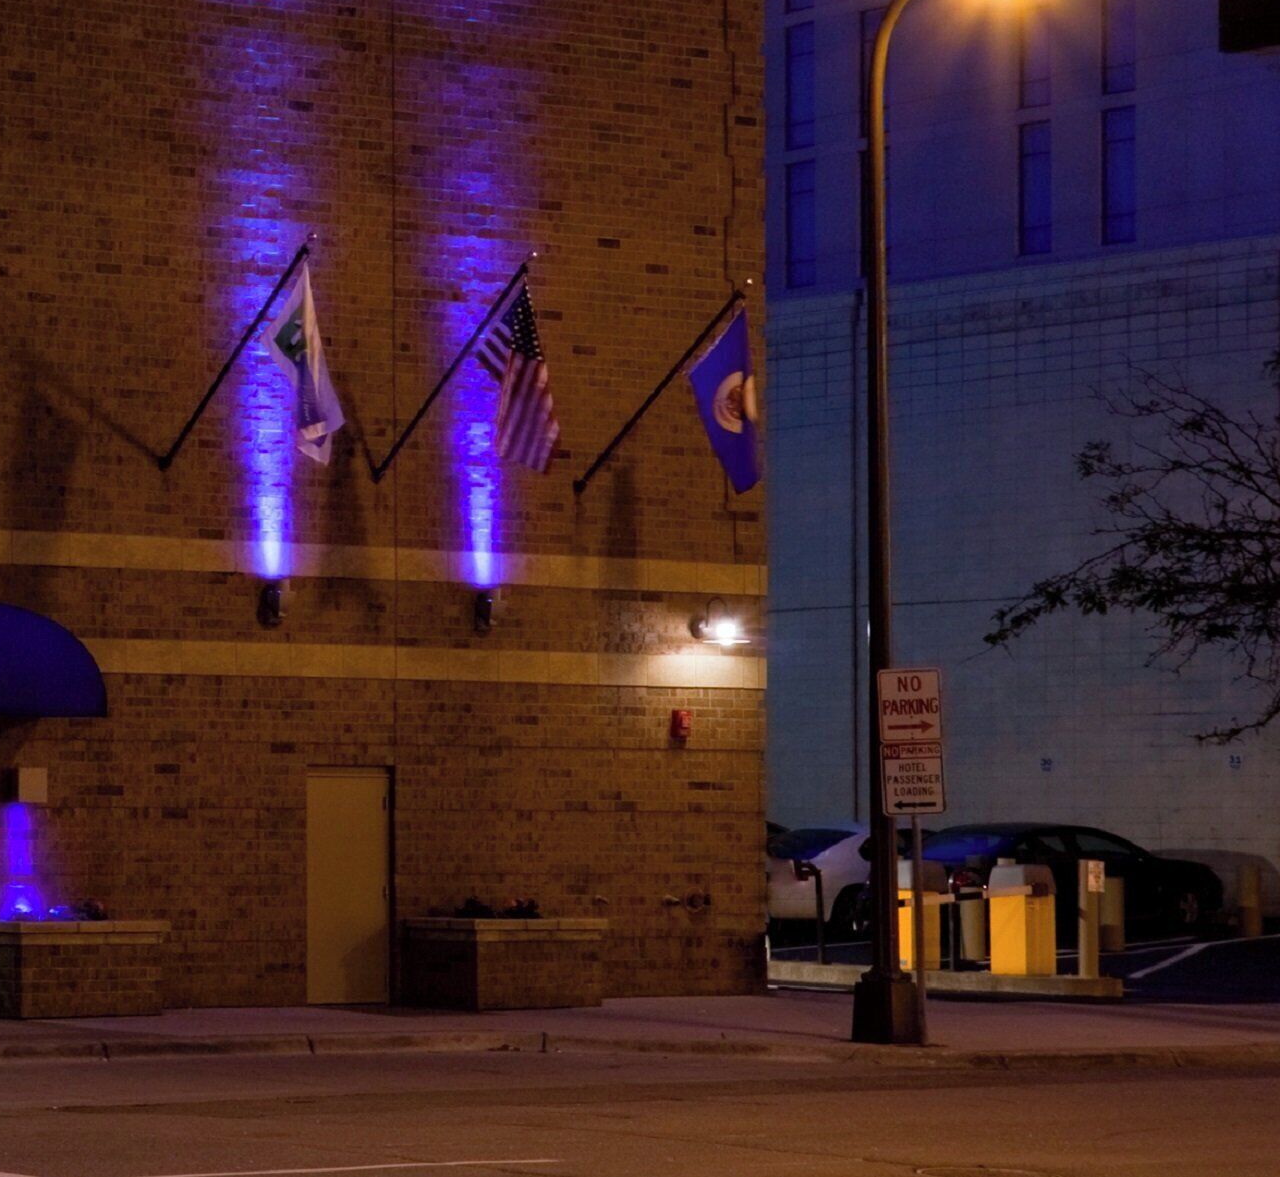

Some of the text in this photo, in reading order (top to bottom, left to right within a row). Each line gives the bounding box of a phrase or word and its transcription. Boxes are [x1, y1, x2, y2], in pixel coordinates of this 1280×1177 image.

[897, 676, 922, 692] NO
[883, 697, 939, 716] PARKING
[883, 745, 940, 758] NO PARKING
[898, 762, 927, 773] HOTEL
[886, 774, 941, 785] PASSENGER
[894, 786, 935, 797] LOADING
